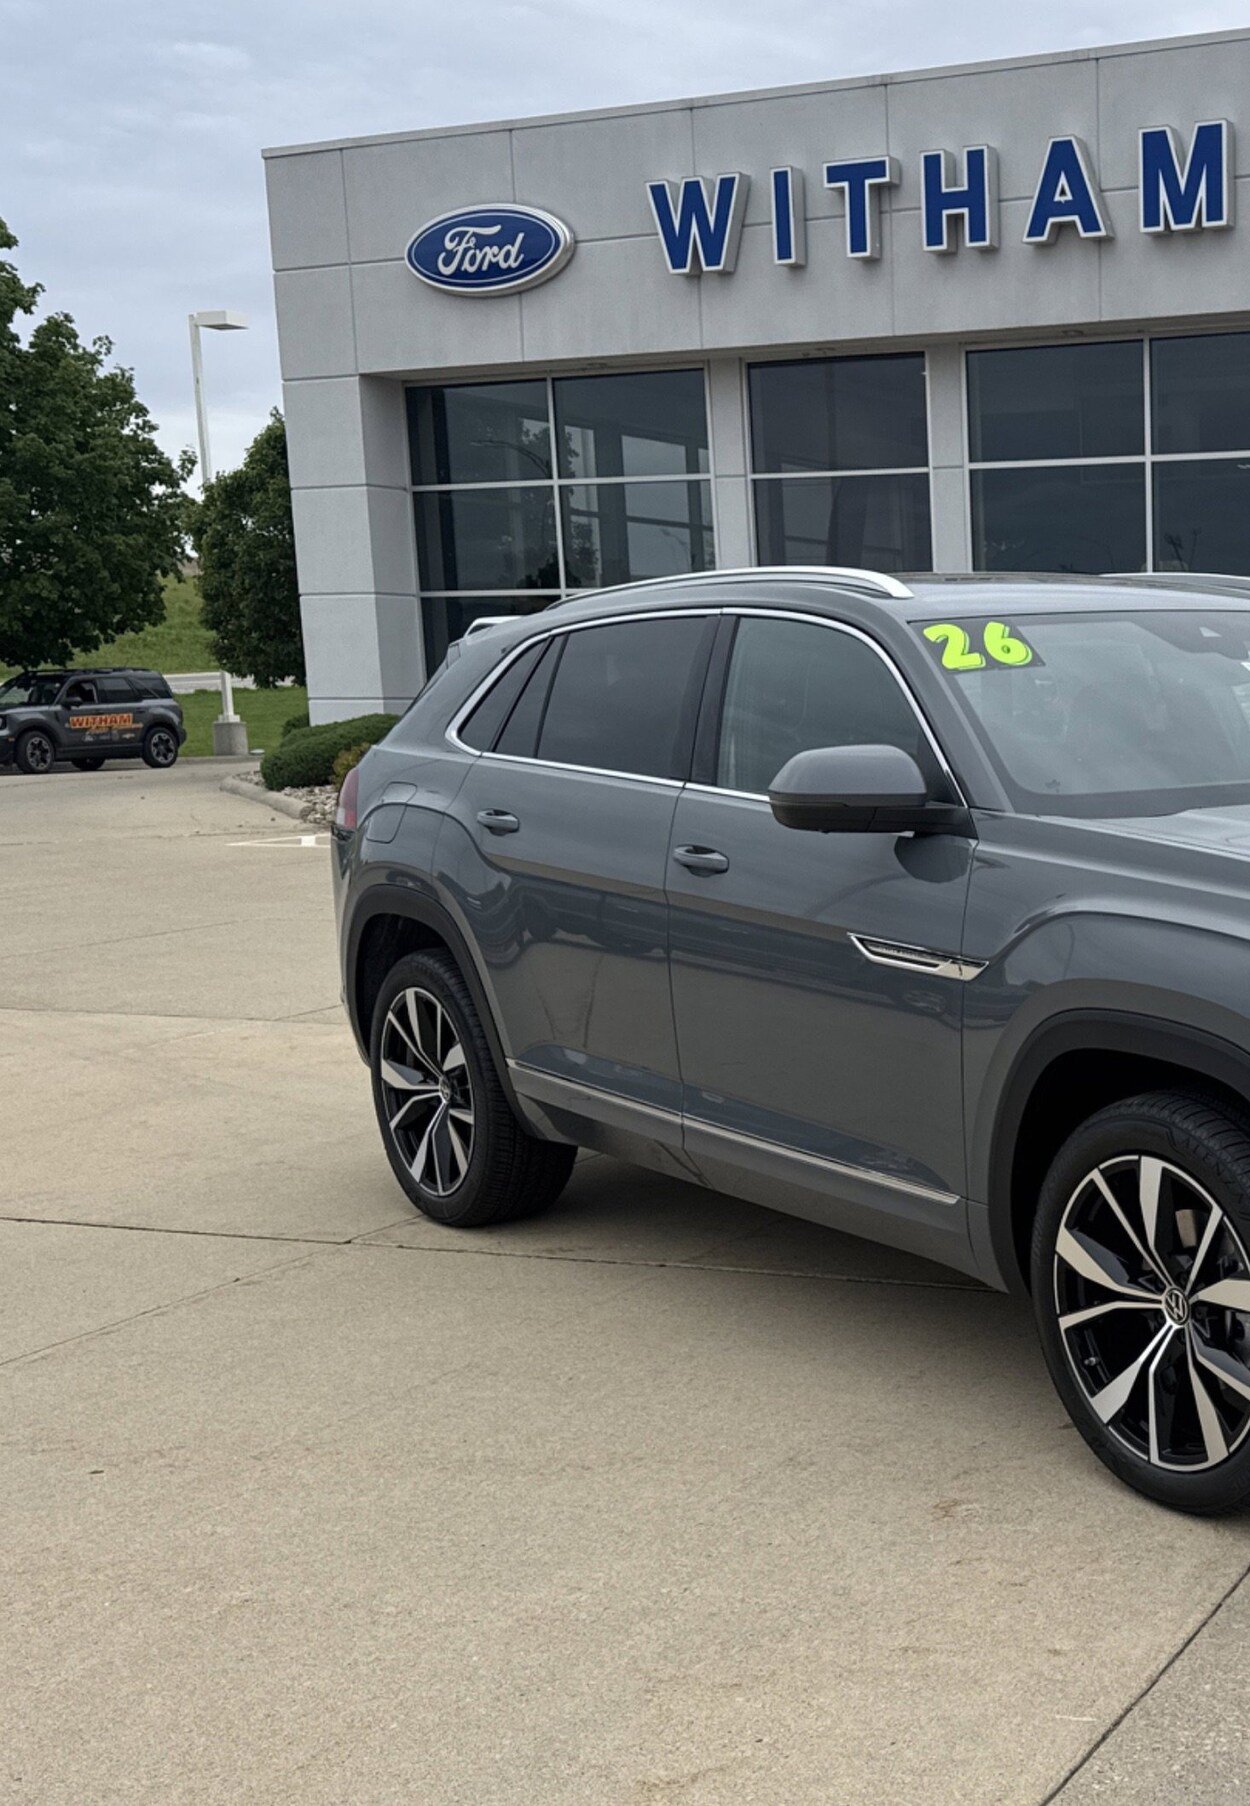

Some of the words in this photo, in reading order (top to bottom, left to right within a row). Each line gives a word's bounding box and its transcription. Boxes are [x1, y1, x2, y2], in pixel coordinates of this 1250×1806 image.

[645, 119, 1232, 275] WITHAM
[437, 225, 525, 276] Ford
[923, 621, 1033, 670] 26
[71, 713, 132, 728] WITHAM
